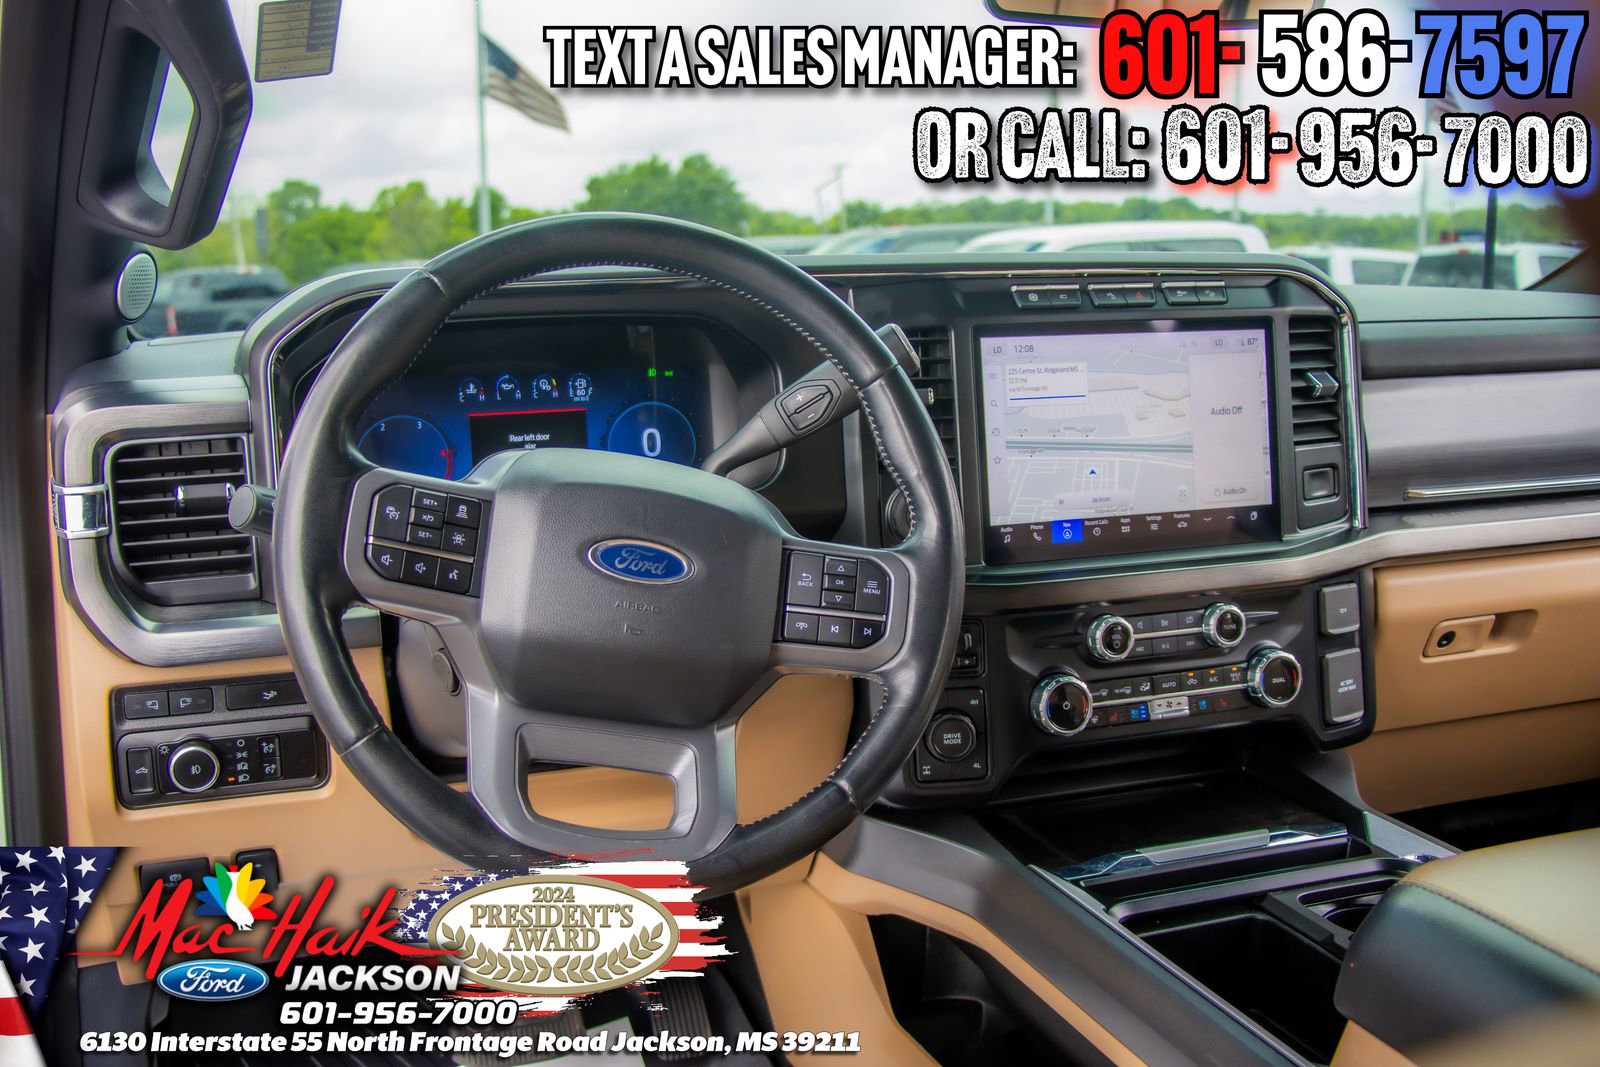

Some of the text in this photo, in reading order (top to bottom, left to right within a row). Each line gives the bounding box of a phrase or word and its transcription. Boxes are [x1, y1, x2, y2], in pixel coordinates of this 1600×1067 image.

[1211, 406, 1242, 416] Audio Off
[380, 424, 386, 432] 2
[416, 421, 422, 430] 3
[642, 428, 662, 458] 0
[1223, 487, 1237, 496] Audio
[614, 547, 666, 575] Ford
